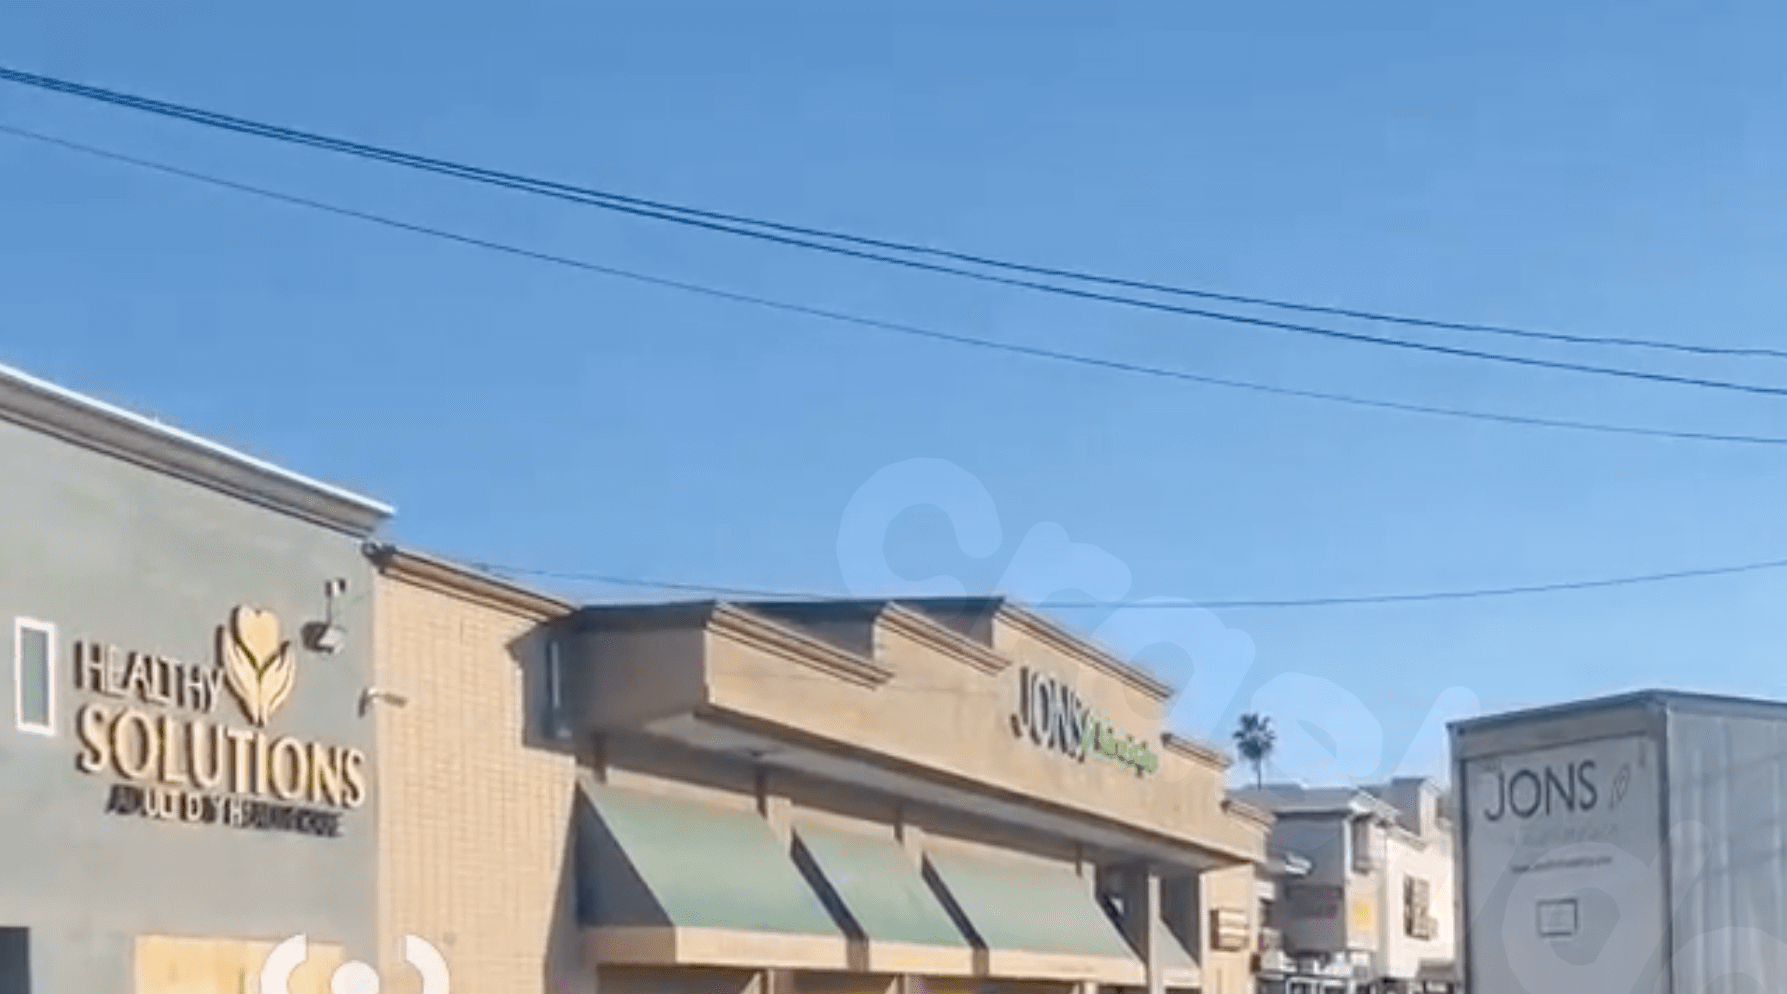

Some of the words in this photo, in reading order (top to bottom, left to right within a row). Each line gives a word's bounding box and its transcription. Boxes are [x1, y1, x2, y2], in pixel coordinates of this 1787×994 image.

[74, 640, 224, 713] HEALTHY
[1008, 664, 1086, 760] JONS
[75, 702, 366, 809] SOLUTIONS
[1483, 758, 1599, 822] JONS
